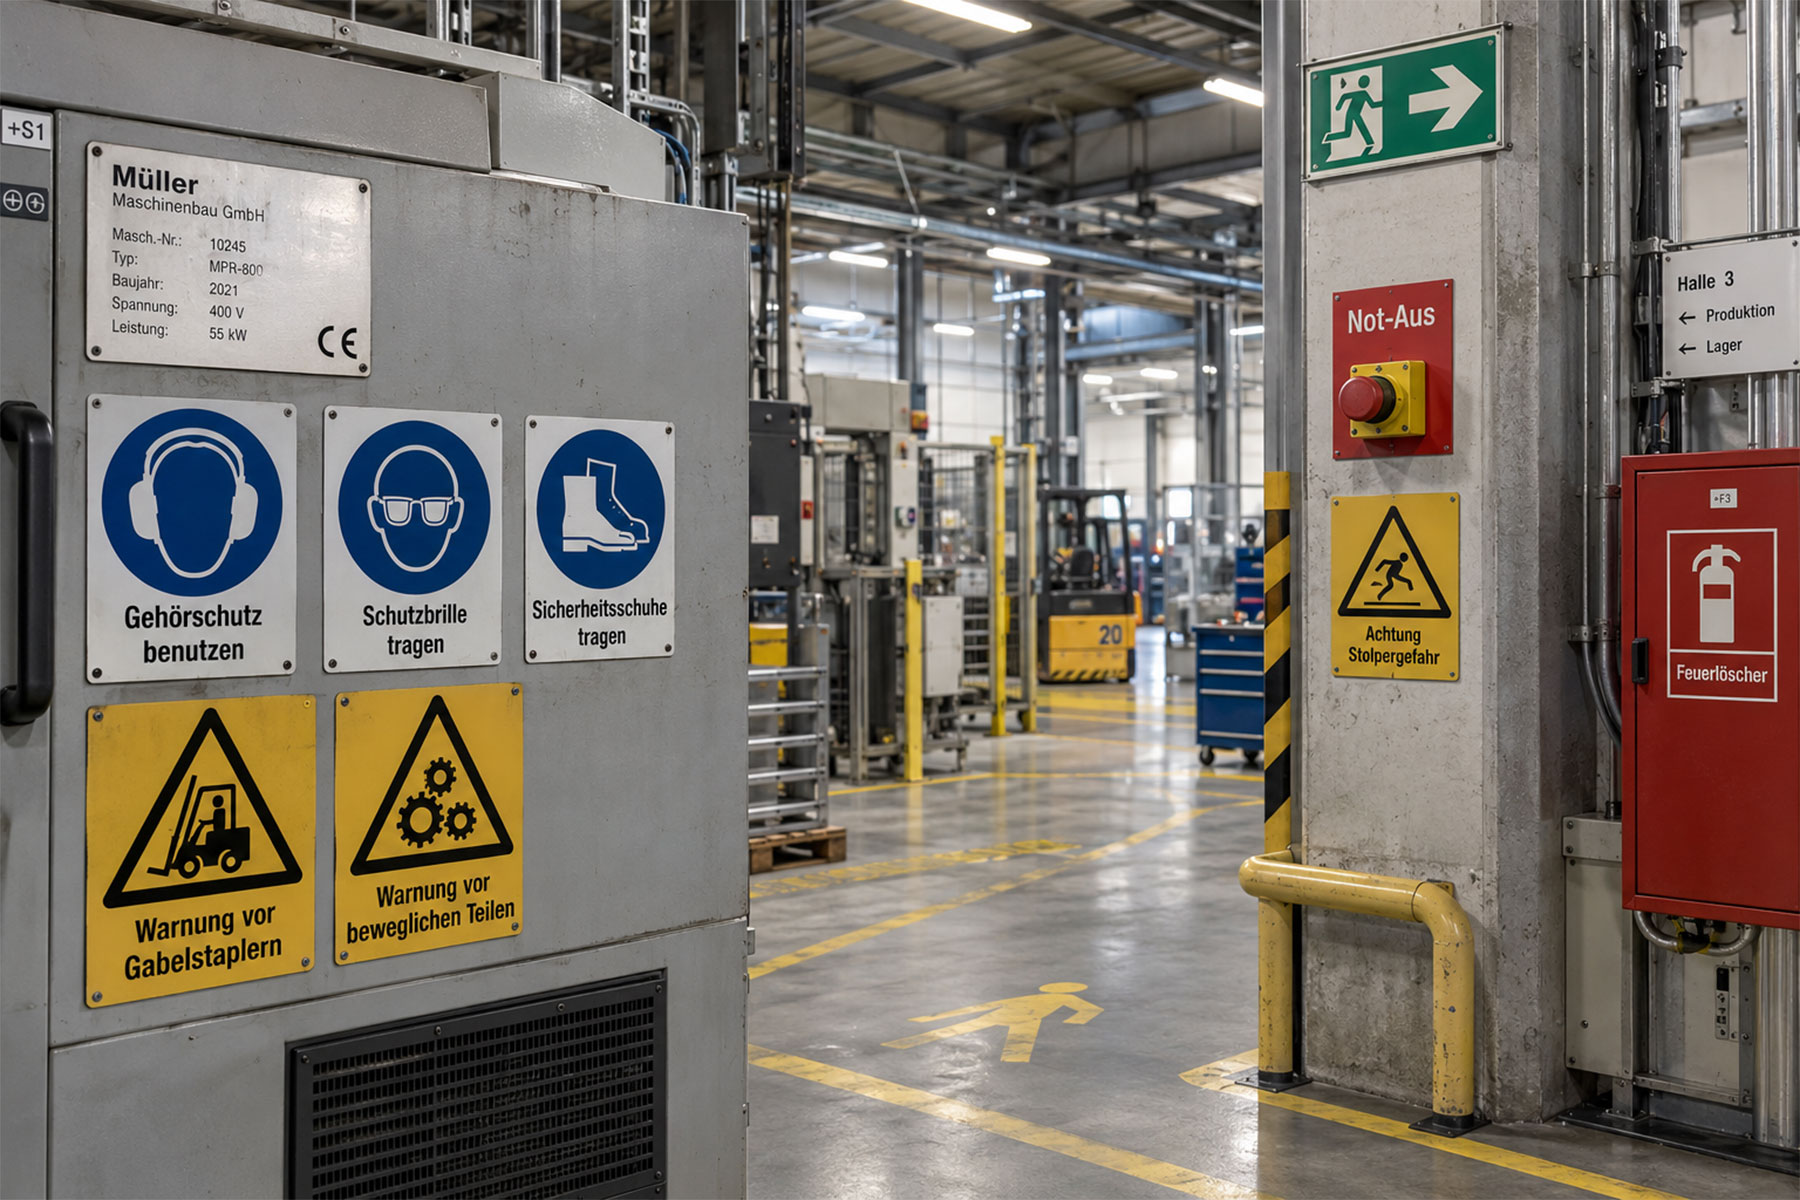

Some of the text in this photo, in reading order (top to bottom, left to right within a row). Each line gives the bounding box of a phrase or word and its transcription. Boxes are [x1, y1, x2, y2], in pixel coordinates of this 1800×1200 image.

[8, 121, 43, 141] +S1
[113, 164, 198, 195] Müller
[113, 193, 264, 222] Maschinenbau GmbH
[113, 227, 246, 253] Masch.-Nr.: 10245
[112, 250, 263, 276] Typ: MPR-800
[113, 273, 237, 296] Baujahr: 2021
[1678, 270, 1735, 291] Halle 3
[112, 296, 244, 319] Spannung: 400 V
[1349, 305, 1435, 333] Not-Aus
[1707, 304, 1774, 322] Produktion
[112, 319, 247, 341] Leistung: 55 kW
[1707, 340, 1742, 355] Lager
[125, 604, 262, 629] Gehörschutz
[363, 604, 467, 626] Schutzbrille
[533, 598, 667, 619] Sicherheitsschuhe
[578, 628, 625, 649] tragen
[1099, 624, 1122, 645] 20
[1366, 626, 1420, 647] Achtung
[144, 640, 243, 663] benutzen
[387, 636, 443, 659] tragen
[1349, 645, 1440, 667] Stolpergefahr
[1676, 664, 1769, 683] Feuerlöscher
[377, 876, 490, 907] Warnung vor
[135, 906, 275, 943] Warnung vor
[347, 901, 515, 943] beweglichen Teilen
[125, 937, 282, 979] Gabelstaplern
